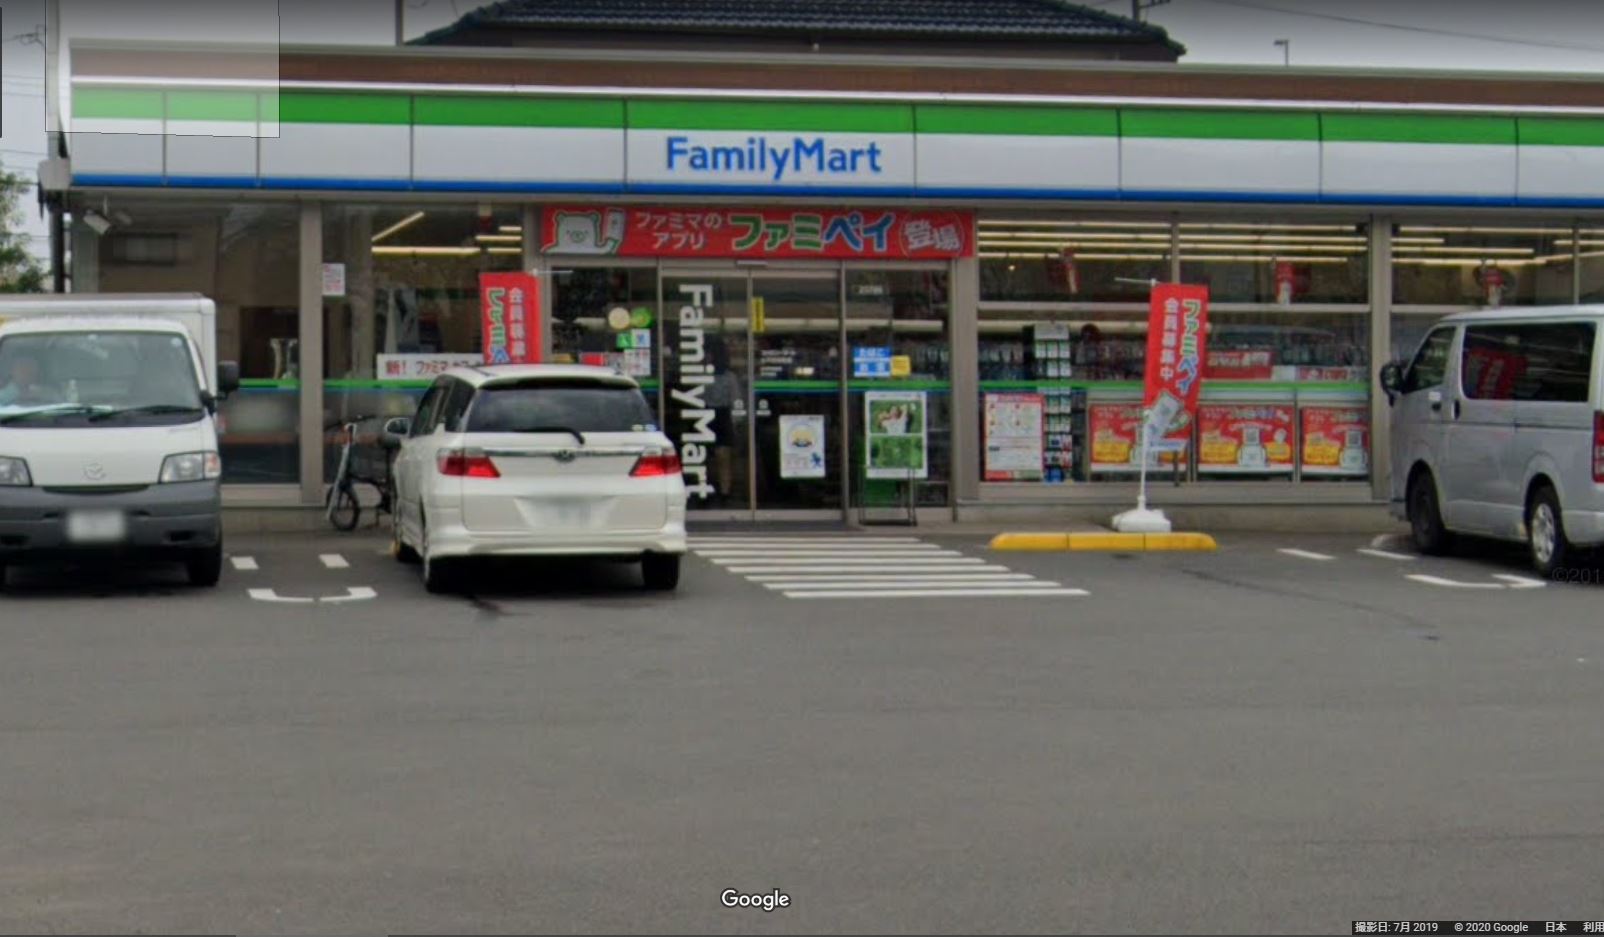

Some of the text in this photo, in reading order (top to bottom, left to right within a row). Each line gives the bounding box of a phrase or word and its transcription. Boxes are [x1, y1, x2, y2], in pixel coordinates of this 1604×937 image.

[666, 136, 882, 181] FamilyMart
[636, 212, 722, 229] ファミマの
[652, 231, 705, 250] アプリ
[728, 211, 896, 251] ファミペイ
[904, 218, 962, 250] 登場
[1176, 298, 1201, 395] ファミペイ
[671, 284, 717, 499] FamilyMart
